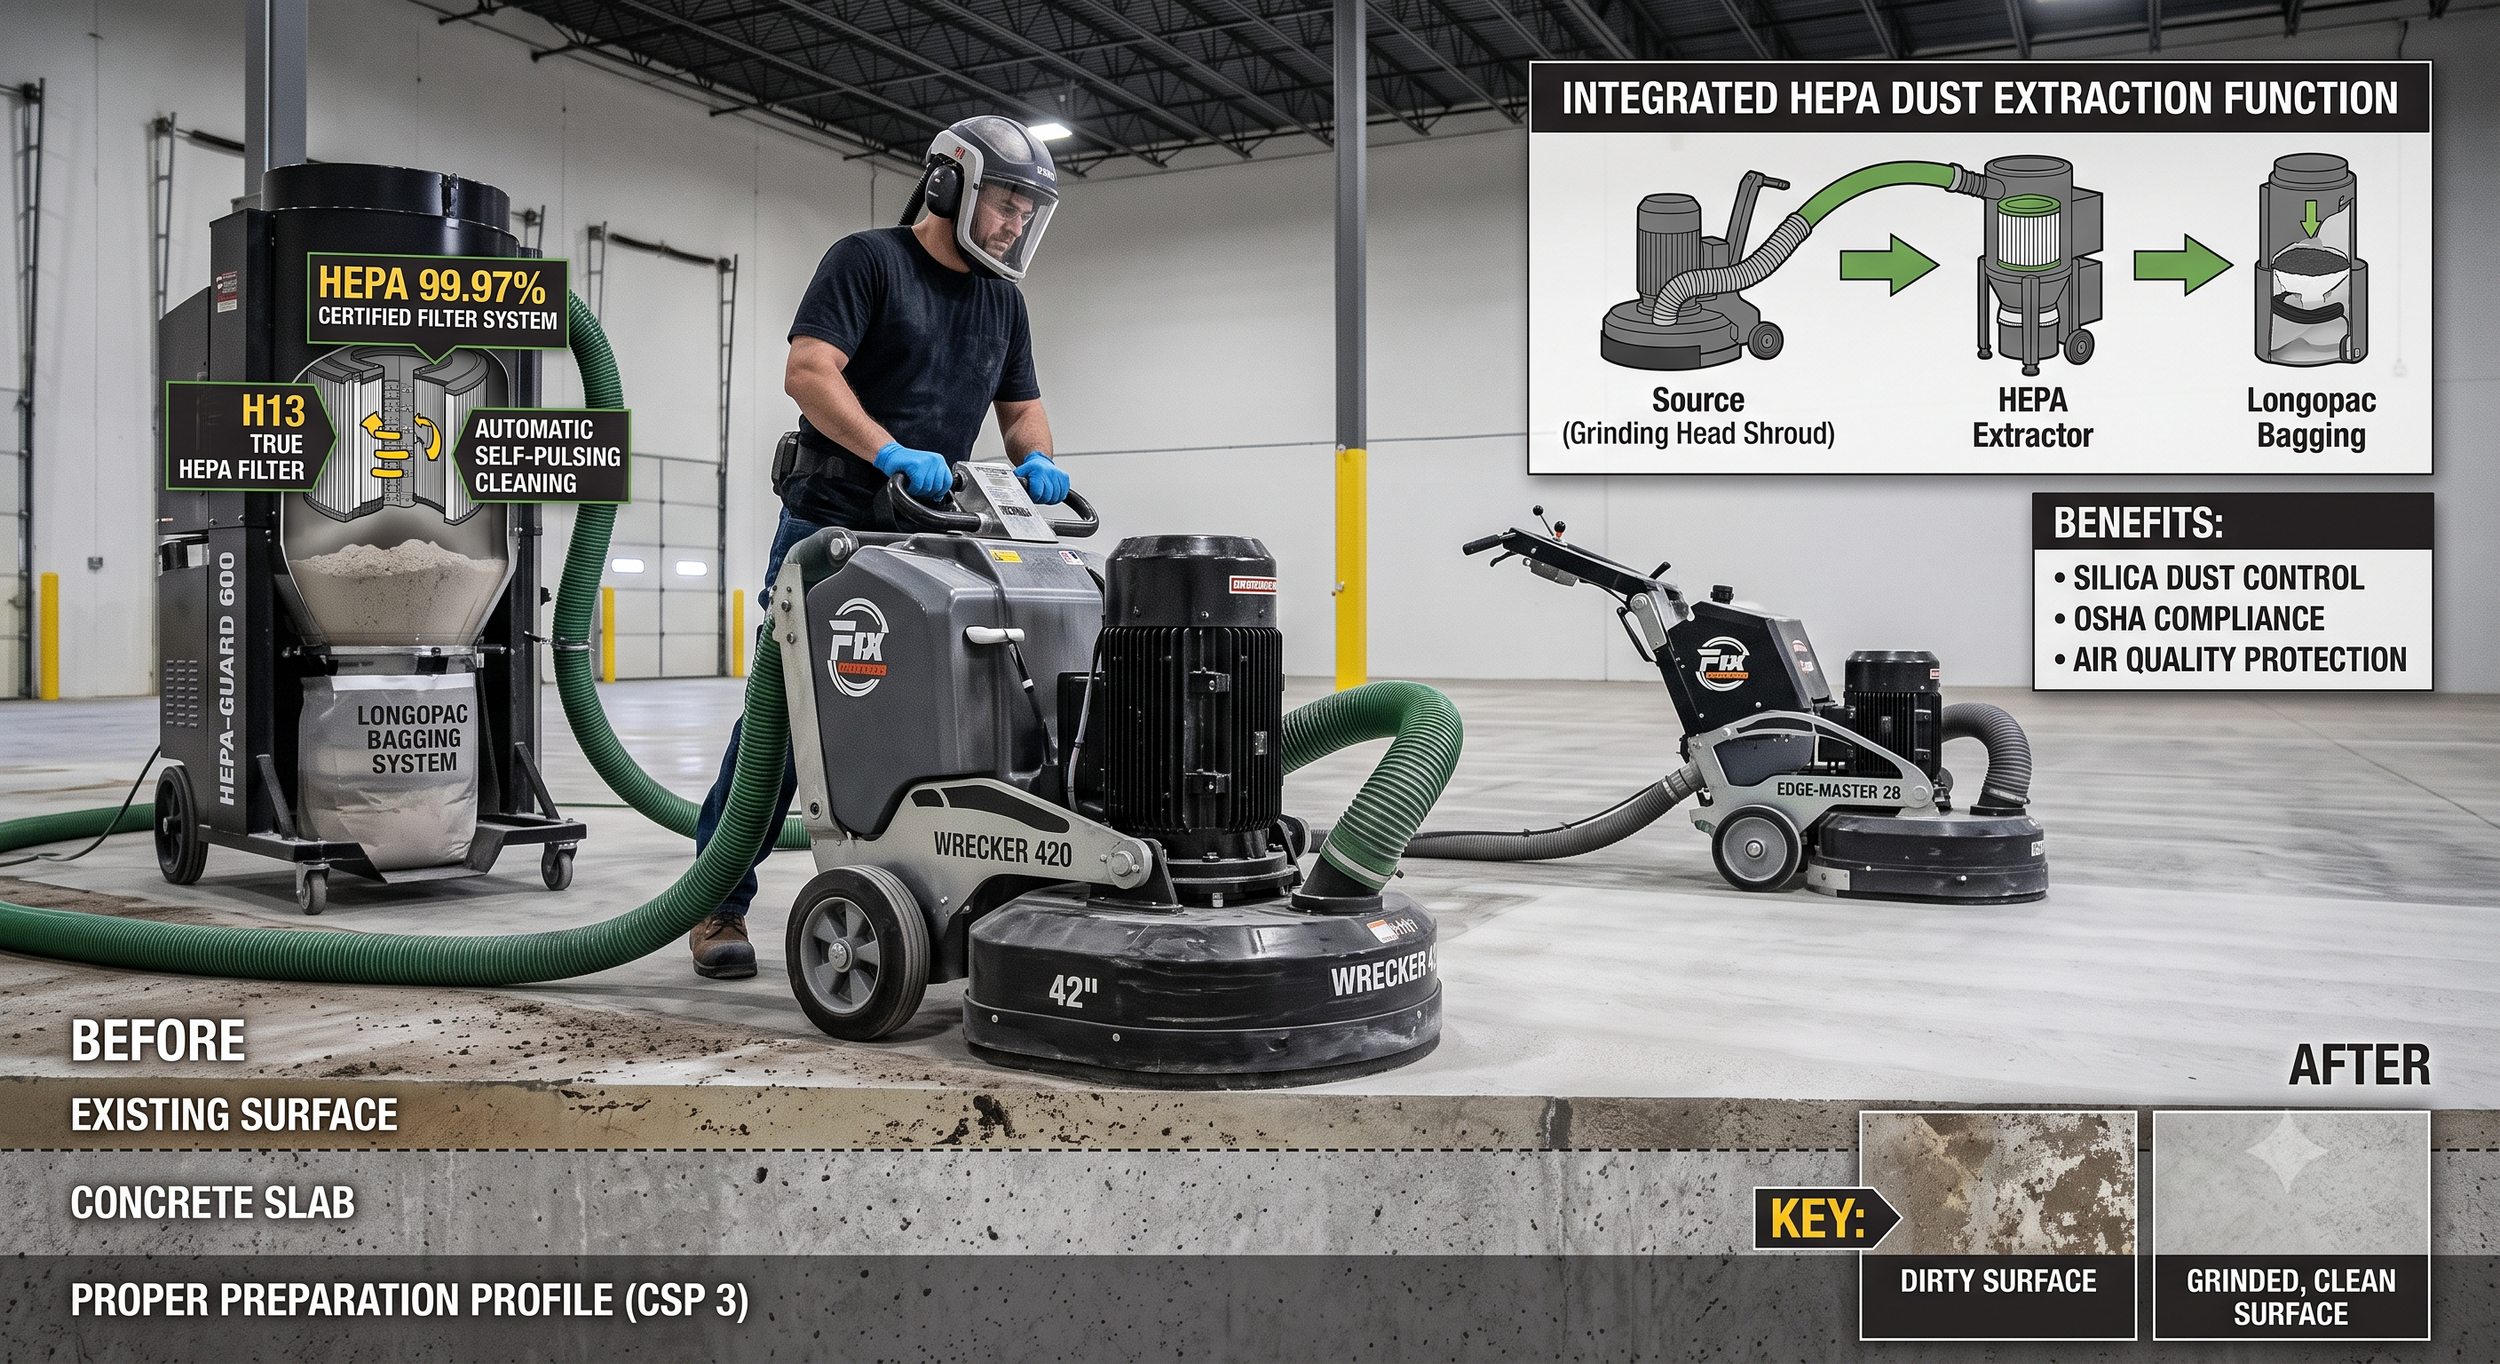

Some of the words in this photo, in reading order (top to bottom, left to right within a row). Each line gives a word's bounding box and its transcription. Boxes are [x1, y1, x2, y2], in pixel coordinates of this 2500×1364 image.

[219, 552, 235, 606] 600
[828, 620, 885, 661] FIX
[1697, 648, 1746, 671] FIX
[219, 615, 235, 806] HEPA-GUARD
[358, 704, 467, 725] LONGOPAC
[368, 728, 460, 749] BAGGING
[373, 752, 456, 774] SYSTEM
[1777, 782, 1877, 799] EDGE-MASTER
[1883, 785, 1901, 799] 28
[934, 831, 1028, 863] WRECKER
[1035, 840, 1072, 867] 420
[1331, 950, 1426, 997] WRECKER
[1049, 975, 1097, 1008] 42"
